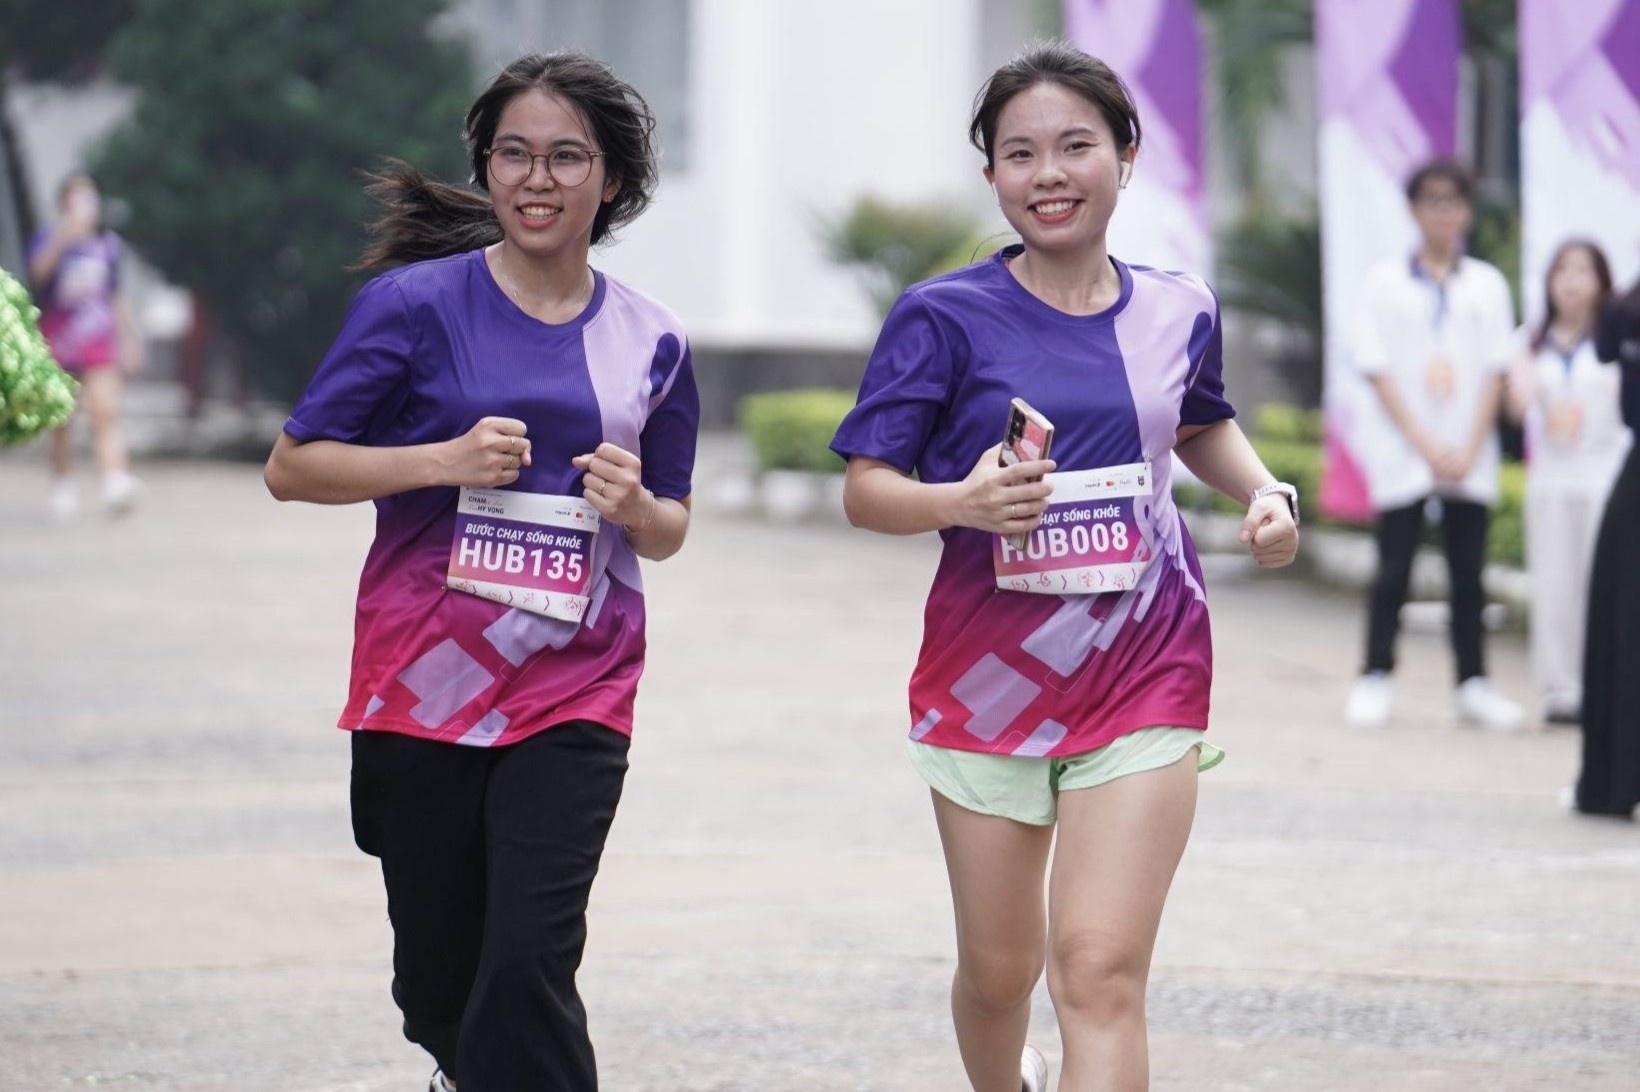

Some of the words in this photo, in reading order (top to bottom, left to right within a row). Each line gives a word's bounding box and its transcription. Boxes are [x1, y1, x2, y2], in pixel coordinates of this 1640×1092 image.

[1038, 512, 1061, 526] HẠY
[1062, 507, 1091, 523] SỐNG
[1093, 504, 1121, 519] KHỎE
[465, 522, 495, 536] BƯỚC
[497, 528, 525, 542] CHẠY
[526, 530, 554, 545] SỐNG
[555, 536, 582, 549] KHỎE
[1001, 521, 1129, 564] HUB008
[458, 537, 584, 583] HUB135
